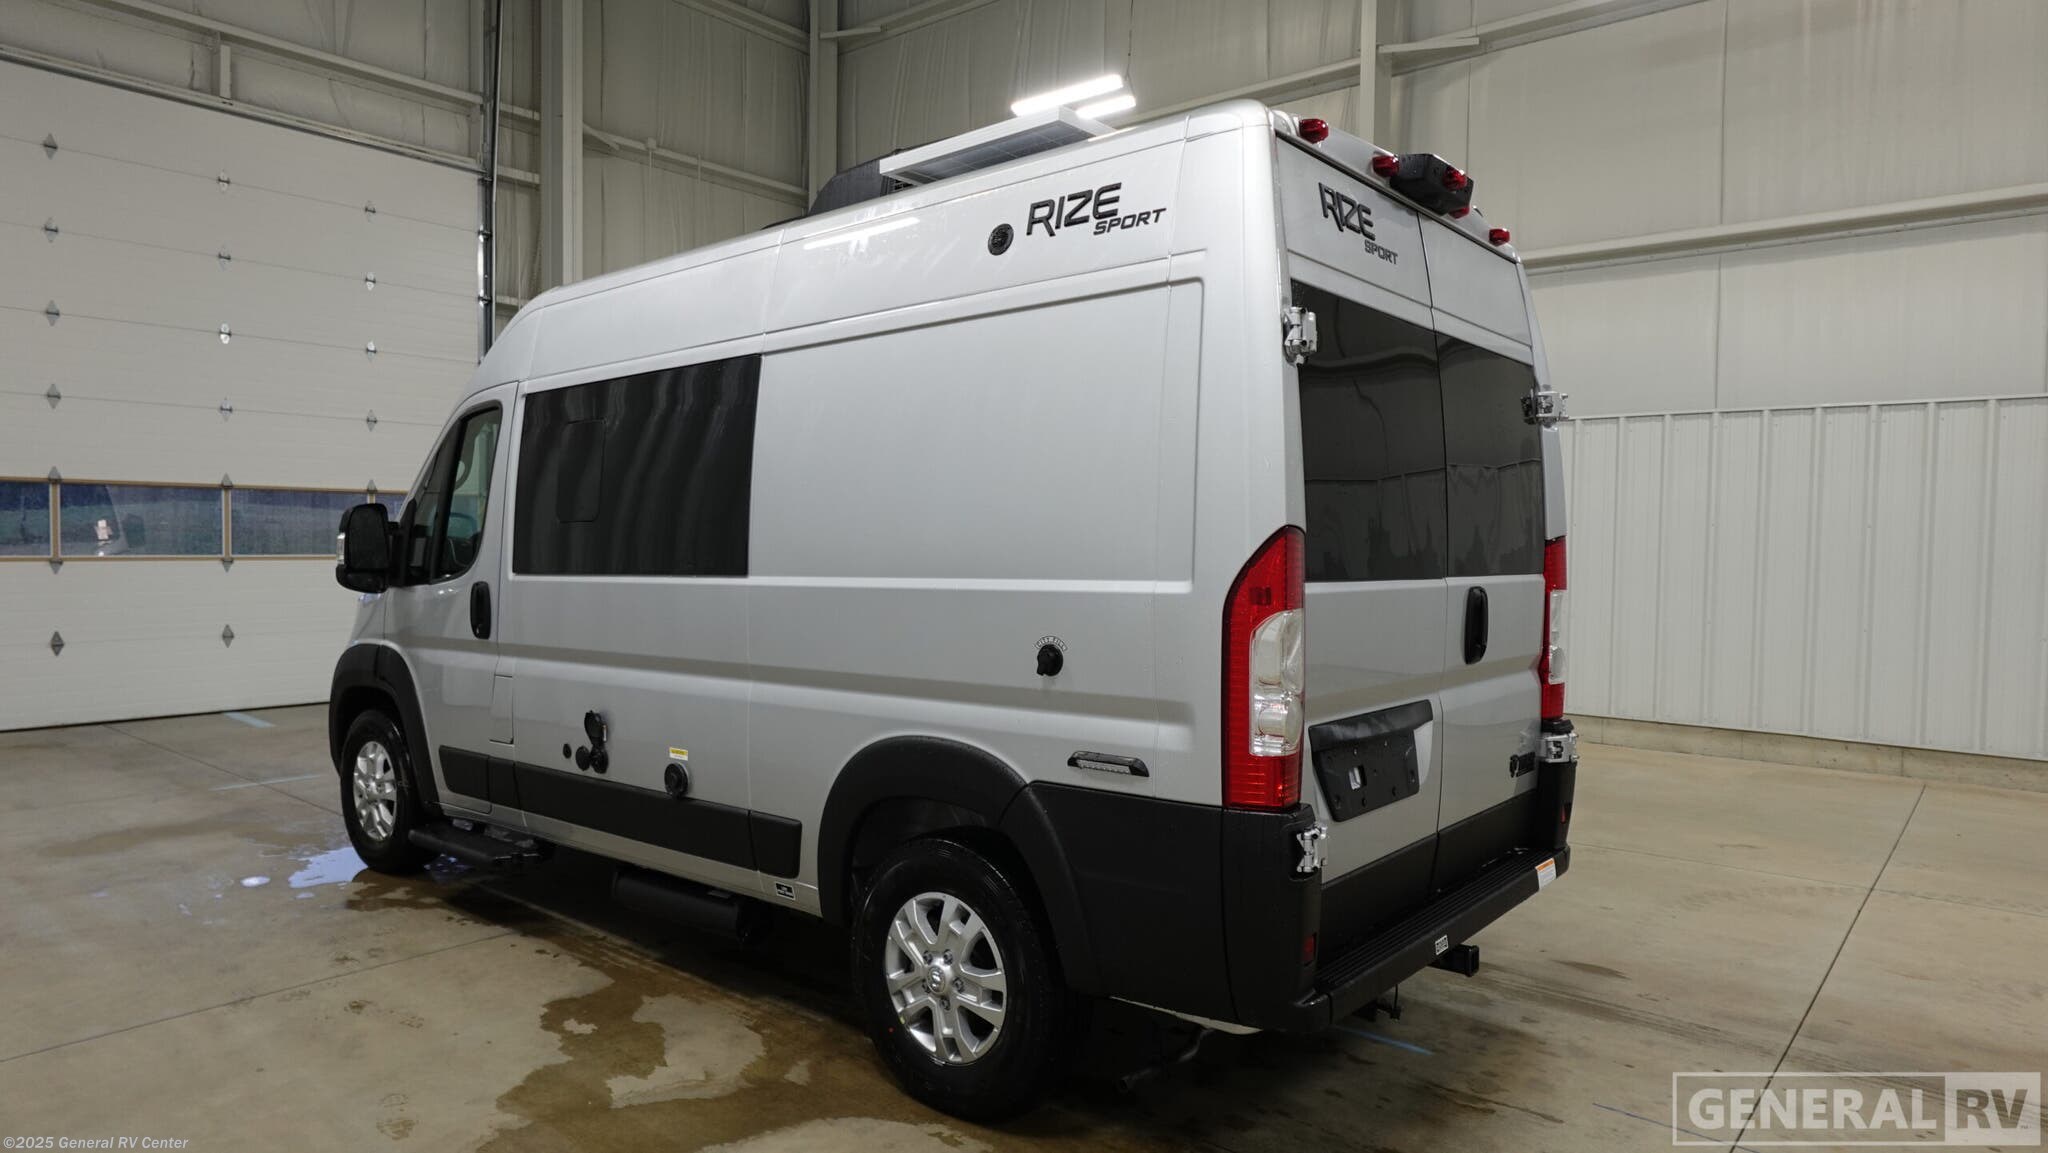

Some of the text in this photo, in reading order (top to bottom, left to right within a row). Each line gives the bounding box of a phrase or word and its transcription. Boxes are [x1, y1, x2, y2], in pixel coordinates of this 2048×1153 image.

[1026, 182, 1122, 237] RIZE
[1093, 207, 1167, 236] SPORT
[1318, 182, 1376, 241] RIZE
[1364, 239, 1398, 265] SPORT
